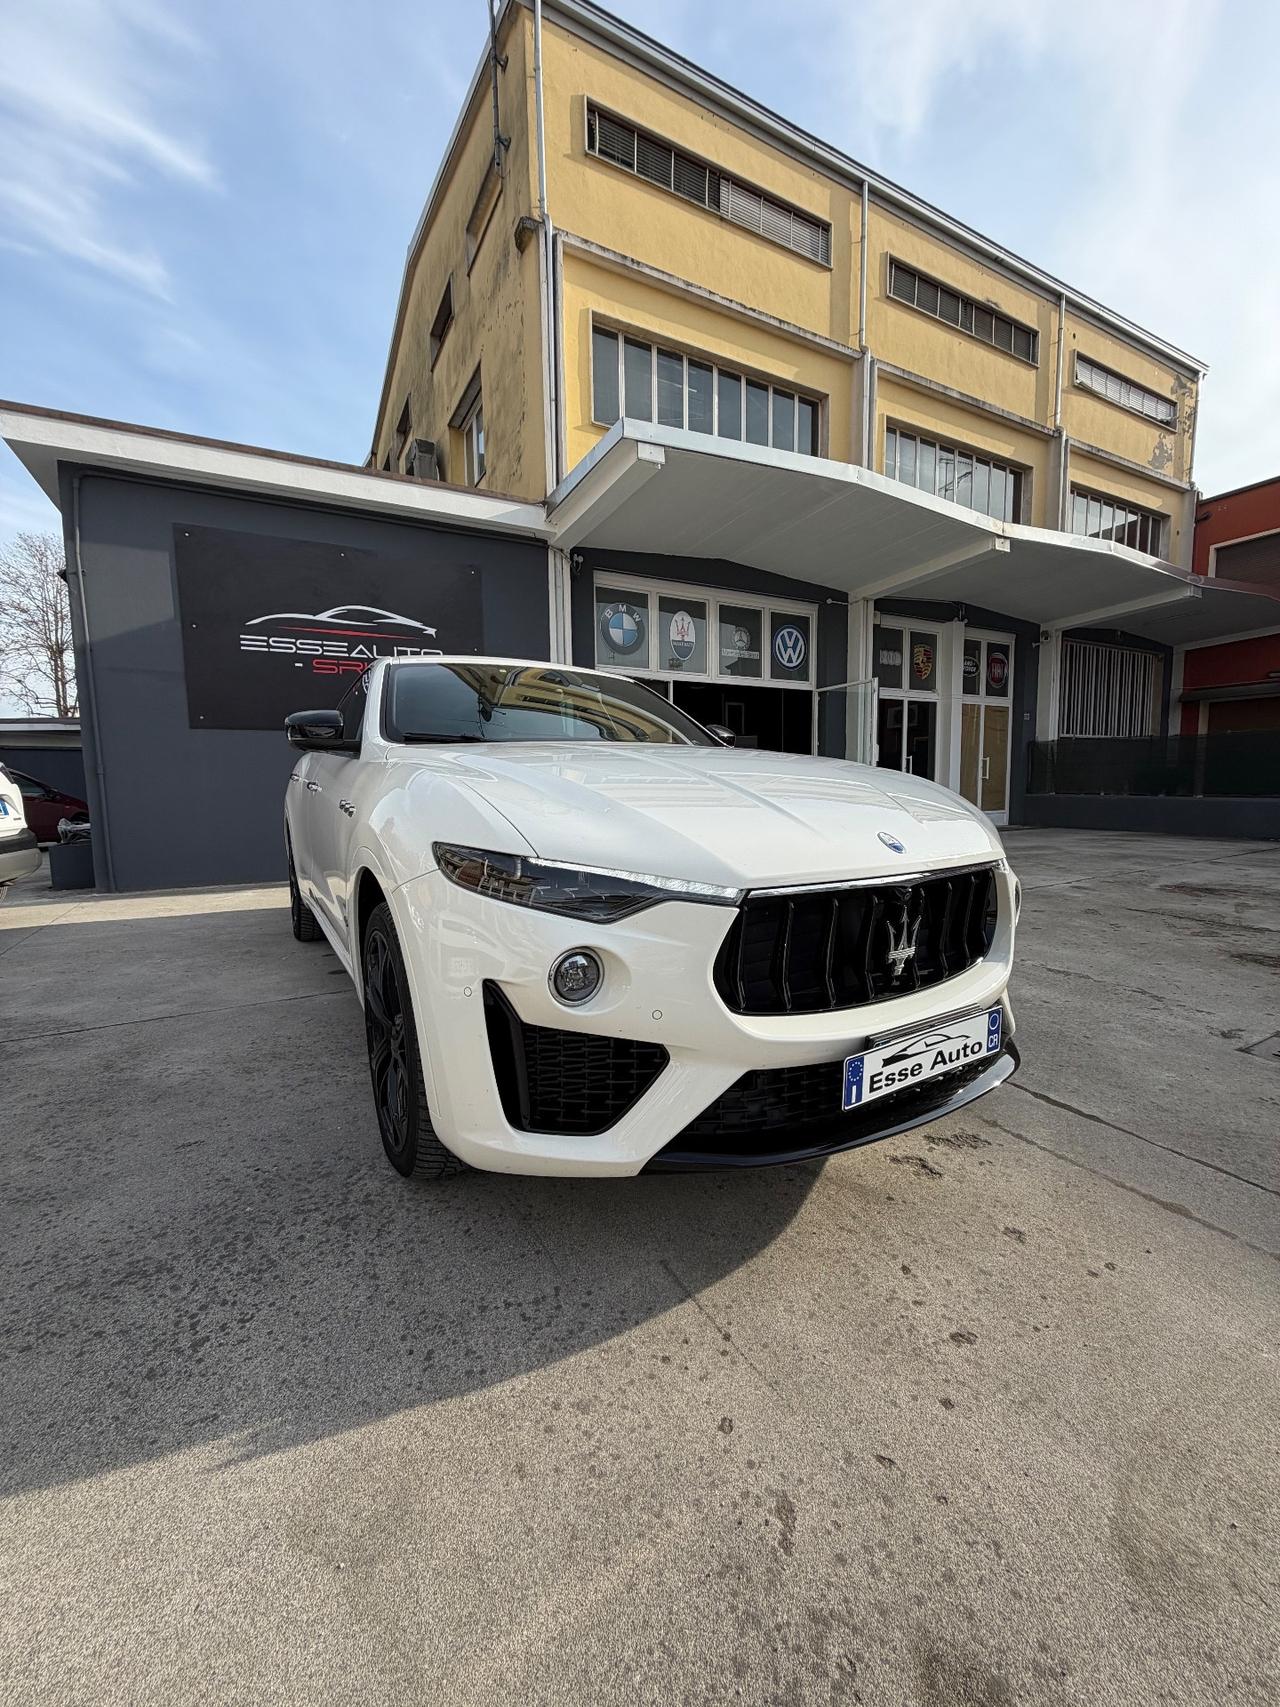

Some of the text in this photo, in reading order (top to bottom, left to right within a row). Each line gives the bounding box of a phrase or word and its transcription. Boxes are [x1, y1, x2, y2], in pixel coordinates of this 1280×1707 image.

[604, 604, 642, 622] BMW
[987, 1033, 999, 1049] CR
[868, 1040, 983, 1094] Esse Auto
